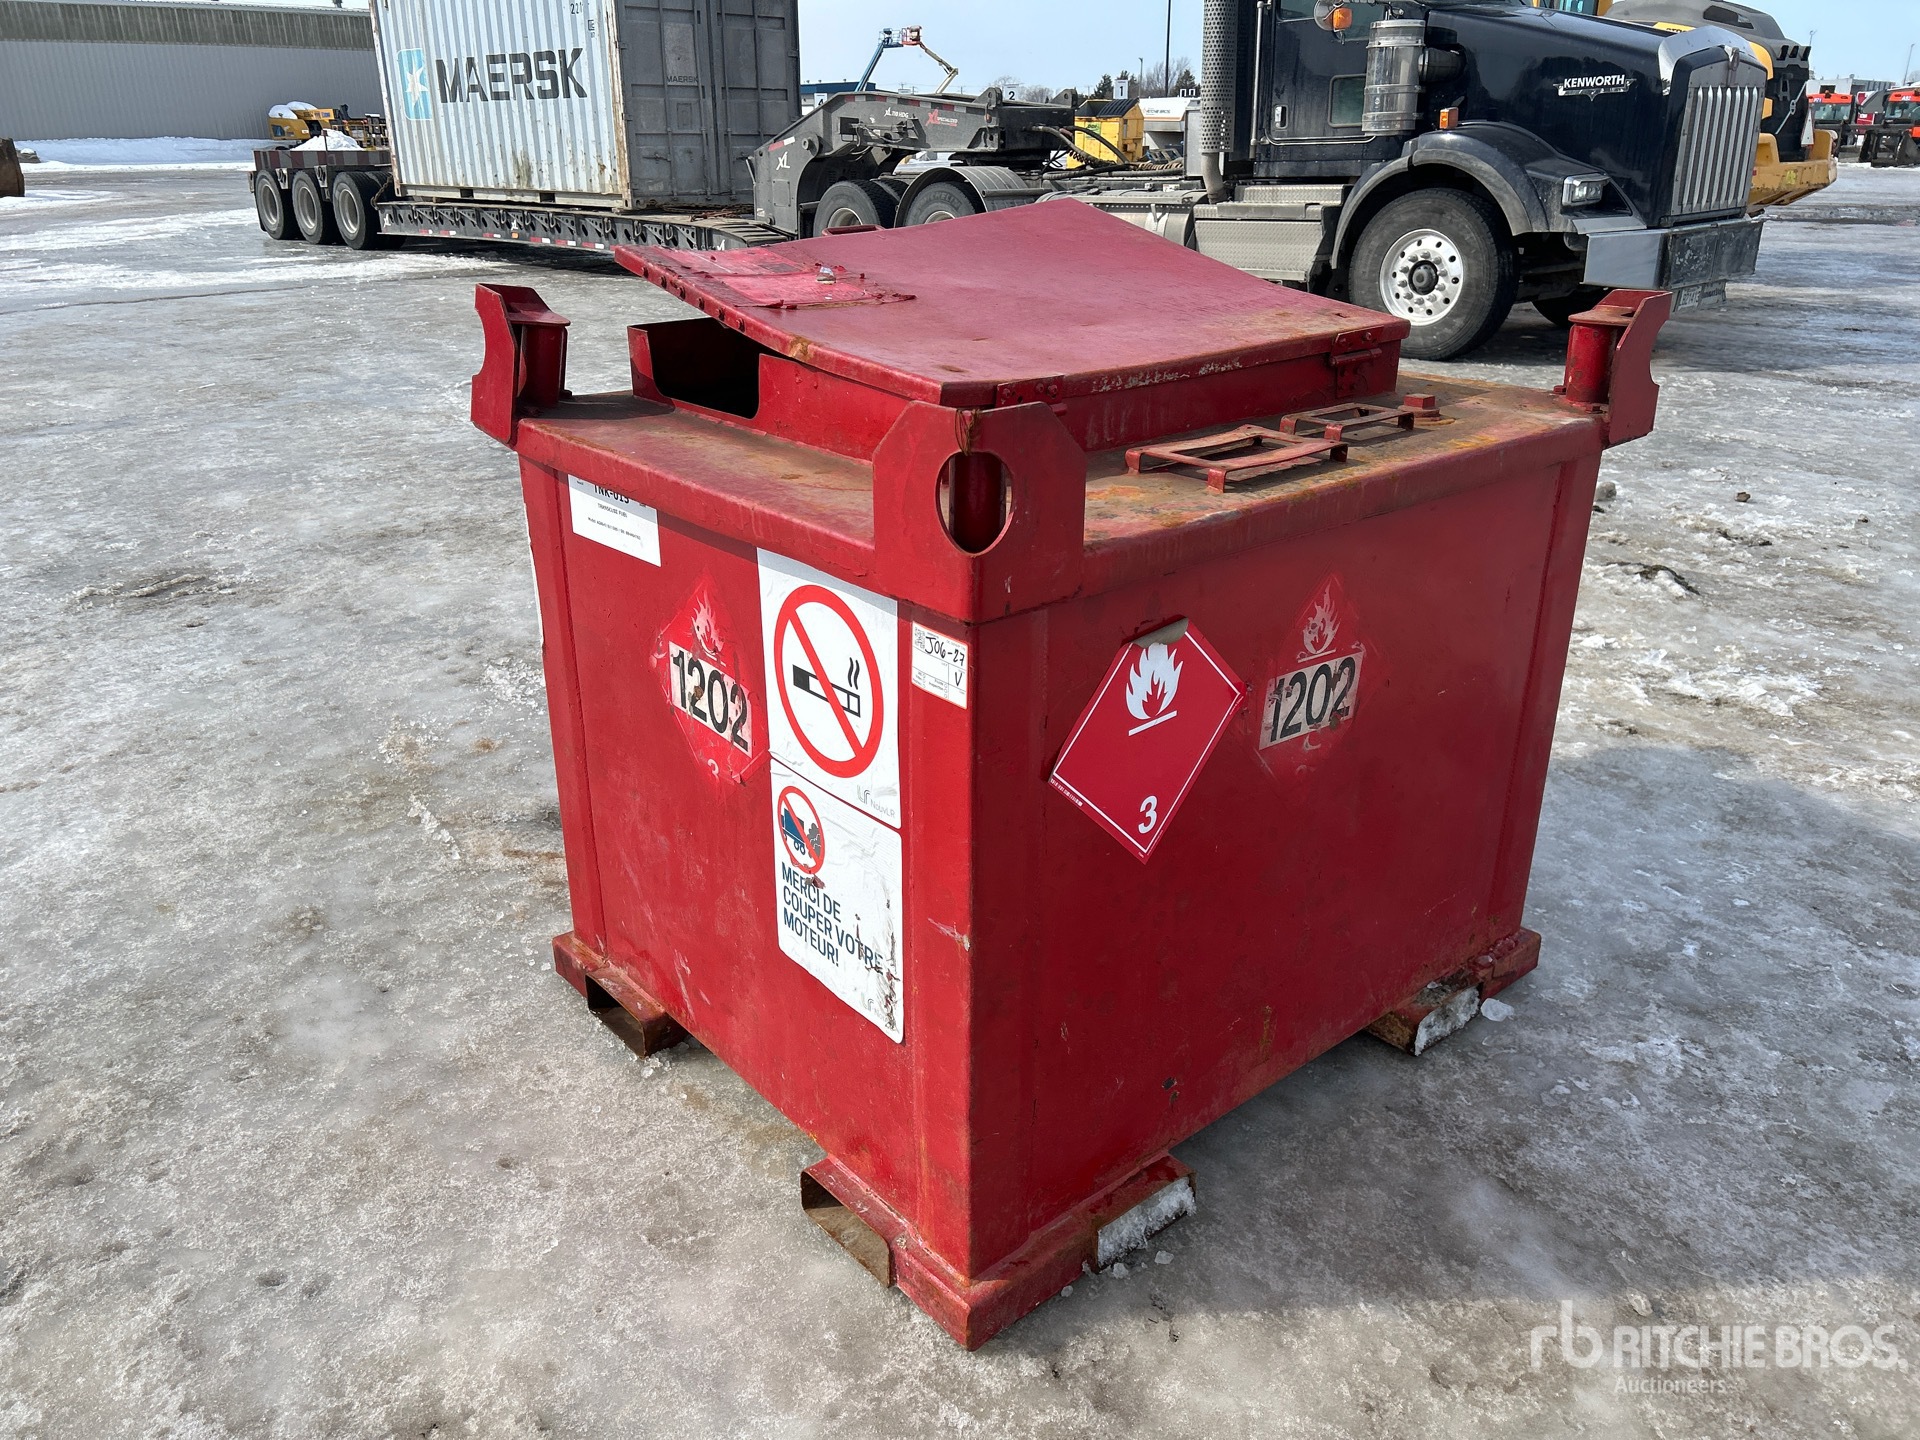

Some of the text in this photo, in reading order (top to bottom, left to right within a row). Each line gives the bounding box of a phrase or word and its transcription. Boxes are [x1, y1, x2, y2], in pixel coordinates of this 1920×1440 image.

[435, 48, 588, 103] MAERSK
[1008, 90, 1016, 101] 2
[1119, 86, 1124, 97] 1
[1563, 74, 1626, 88] KENWORTH
[775, 151, 791, 171] XL
[673, 649, 749, 753] 1202
[1269, 656, 1356, 743] 1202
[1138, 795, 1158, 834] 3
[781, 861, 842, 923] MERCI DE
[783, 885, 884, 976] COUPER VOTRE
[783, 906, 839, 968] MOTEUR!
